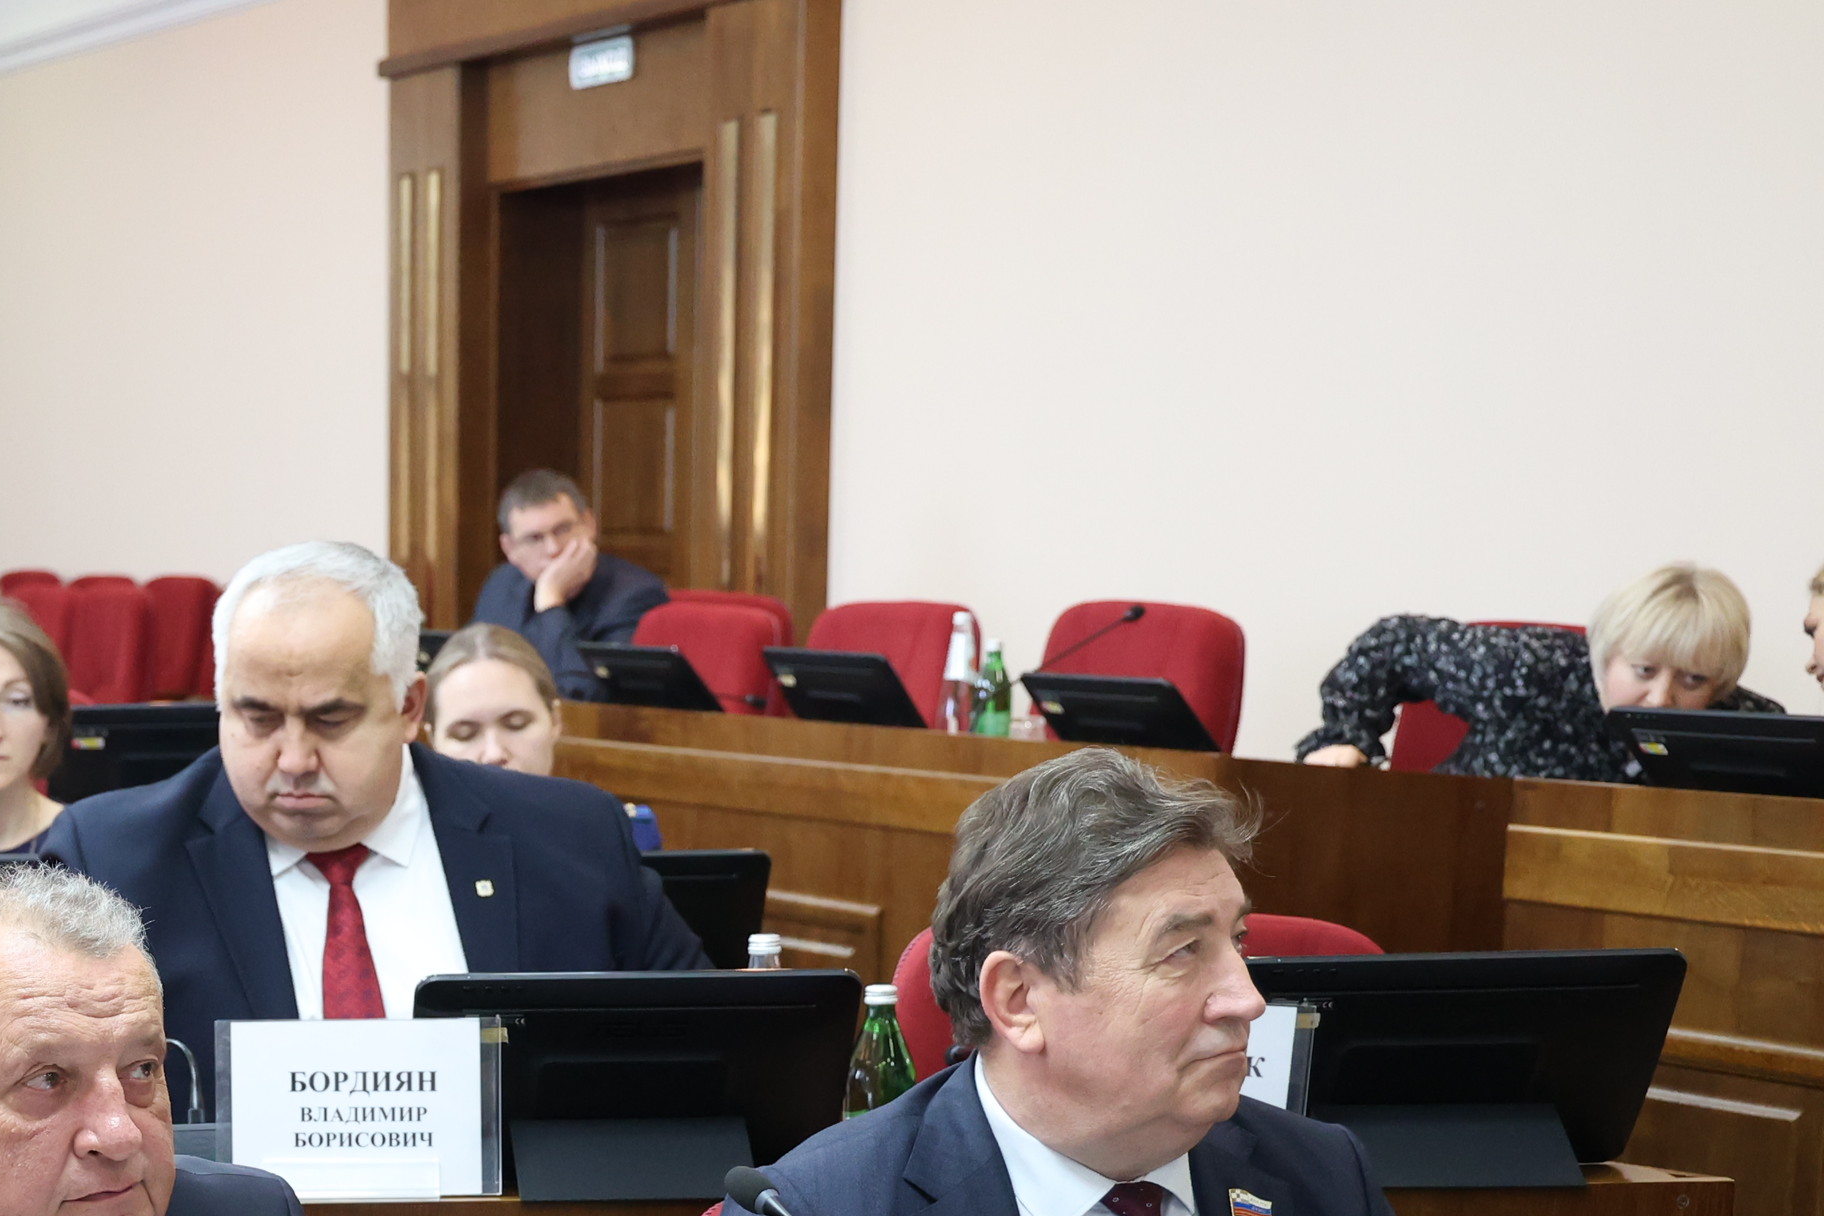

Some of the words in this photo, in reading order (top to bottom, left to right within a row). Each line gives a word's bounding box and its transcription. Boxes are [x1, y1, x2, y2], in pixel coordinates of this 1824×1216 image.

[288, 1070, 439, 1098] БОРДИЯН
[299, 1106, 429, 1125] ВЛАДИМИР
[293, 1131, 435, 1148] БОРИСОВИЧ
